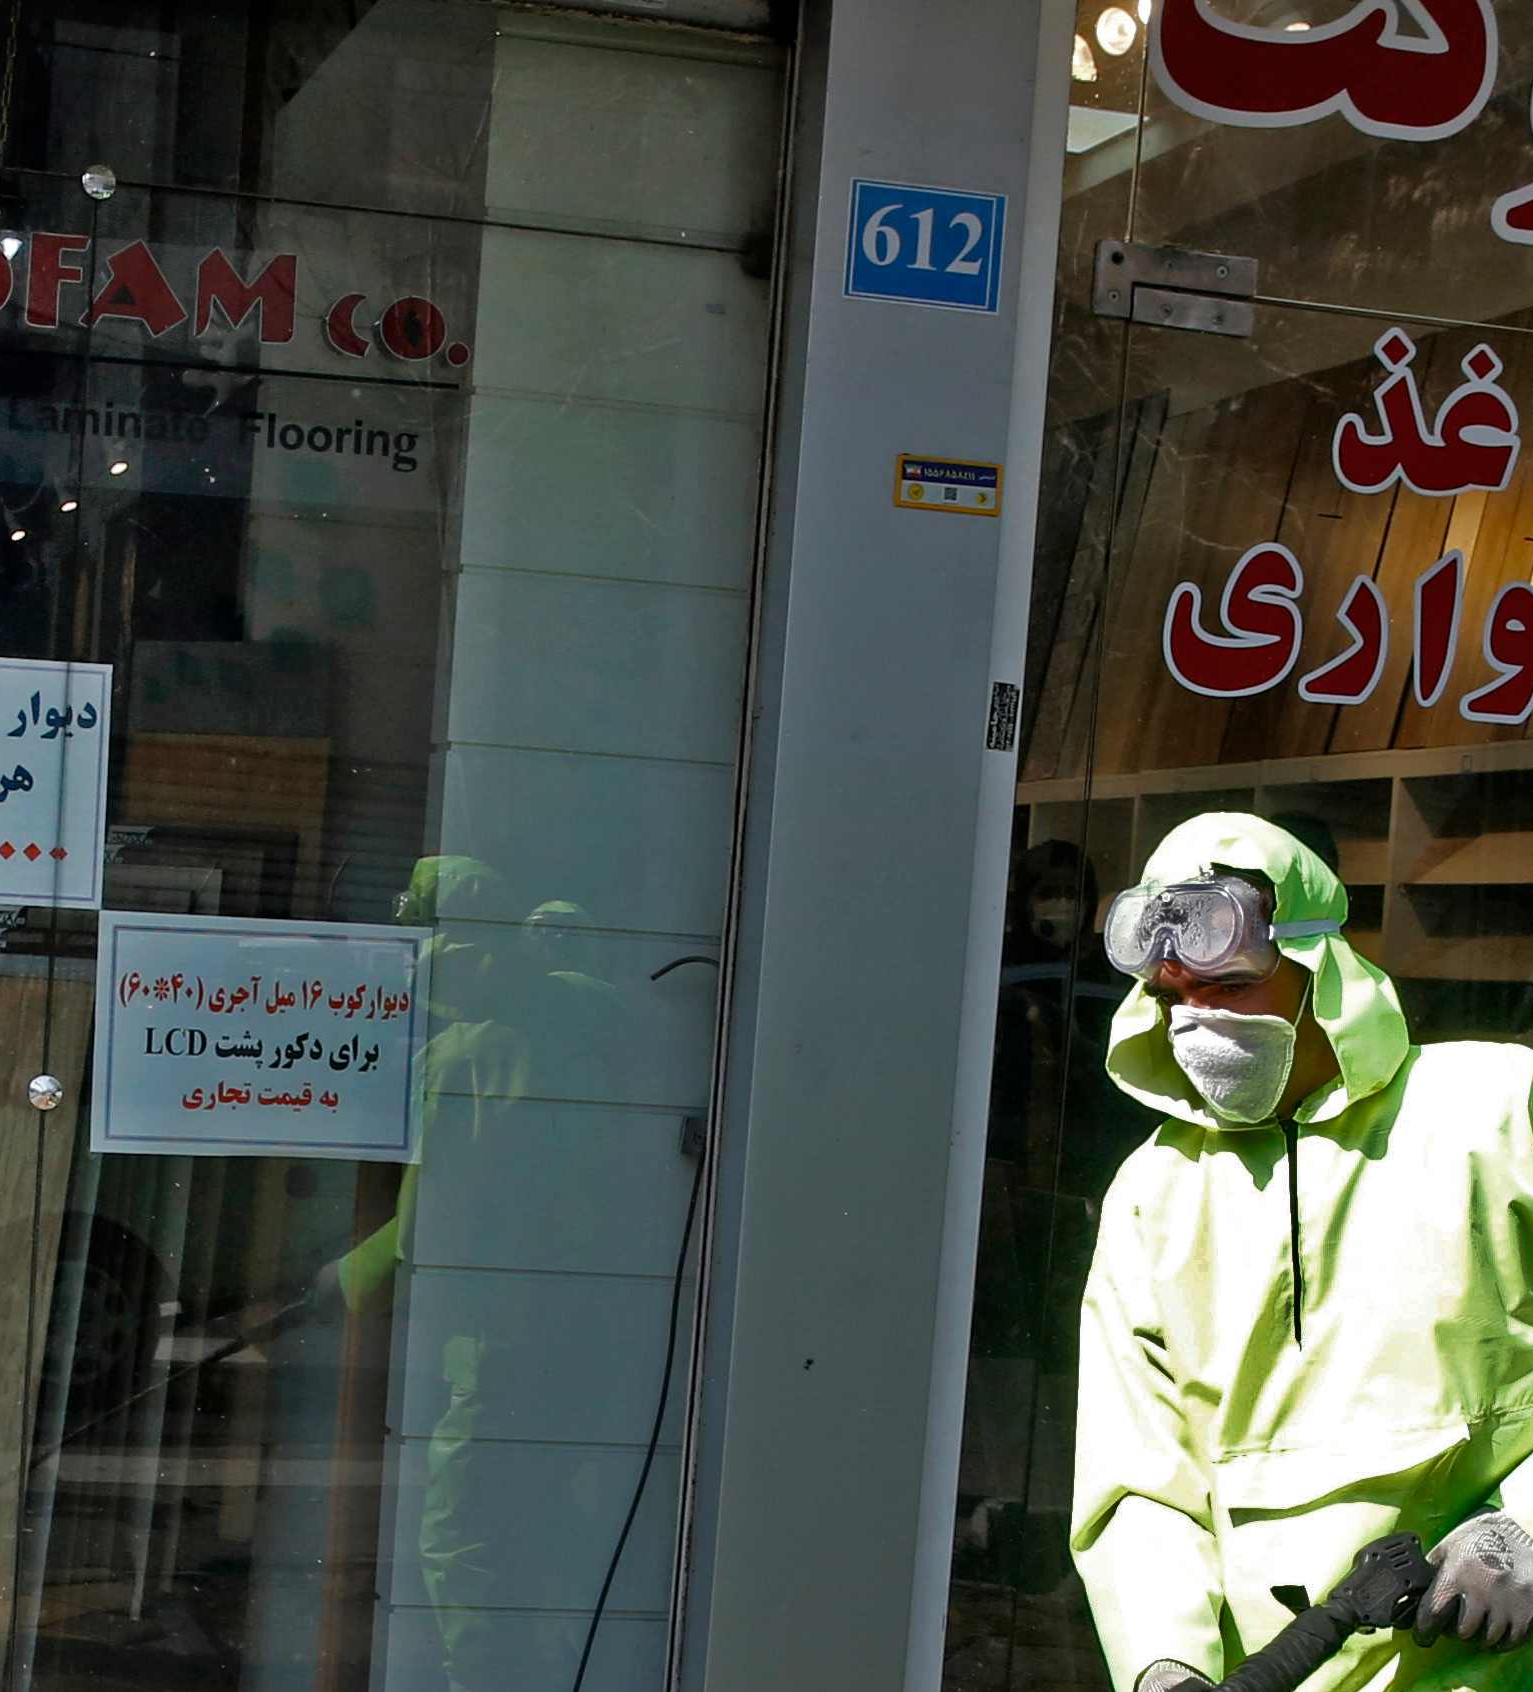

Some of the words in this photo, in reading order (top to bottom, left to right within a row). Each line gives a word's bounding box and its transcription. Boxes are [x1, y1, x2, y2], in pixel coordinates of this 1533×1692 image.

[861, 203, 984, 275] 612
[8, 399, 210, 443] Laminate
[239, 411, 418, 472] Flooring
[7, 691, 98, 740] دیوار
[208, 976, 261, 1013] آجری
[266, 981, 295, 1015] میل
[302, 980, 323, 1010] ۱۶
[145, 1027, 207, 1057] LCD
[215, 1031, 263, 1068] پشت
[269, 1032, 323, 1069] دکور
[329, 1035, 379, 1071] برای
[182, 1081, 252, 1110] تجاری
[257, 1083, 313, 1112] قیمت
[319, 1090, 339, 1113] به
